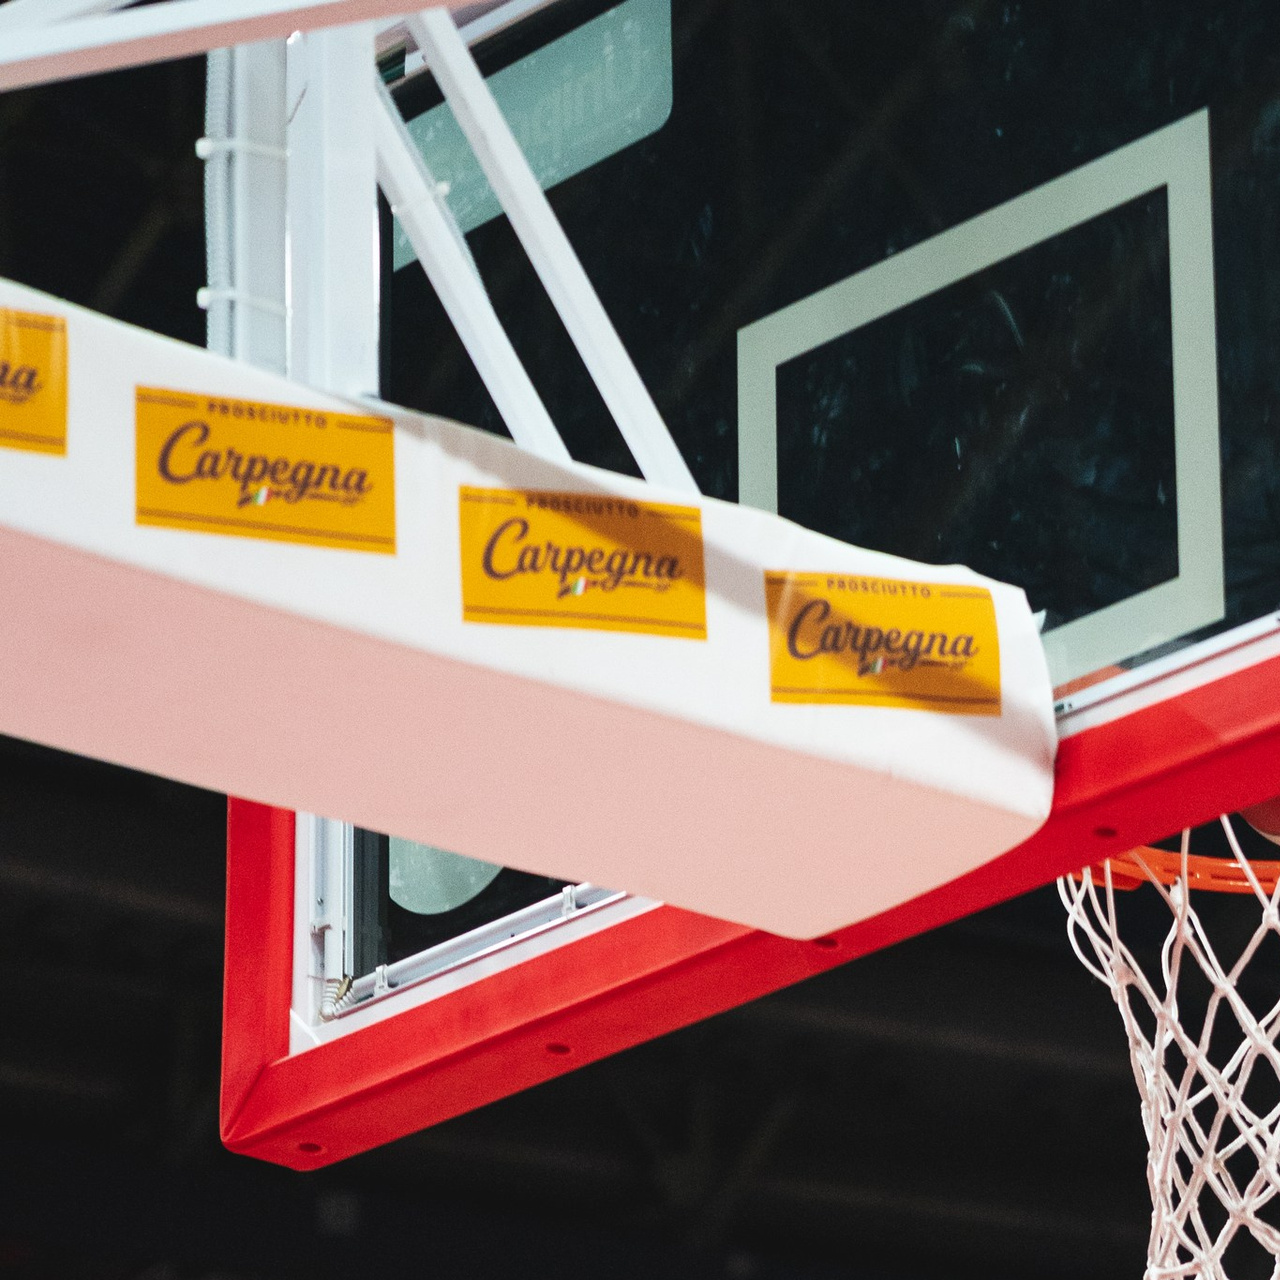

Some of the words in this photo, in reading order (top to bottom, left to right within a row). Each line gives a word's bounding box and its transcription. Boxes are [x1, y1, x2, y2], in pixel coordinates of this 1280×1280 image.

[206, 400, 328, 430] PROSCIUTTO
[158, 420, 373, 508] Carpegna
[482, 516, 683, 599] Carpegna
[826, 577, 932, 599] PROSCIUTTO
[787, 599, 979, 677] Carpegna
